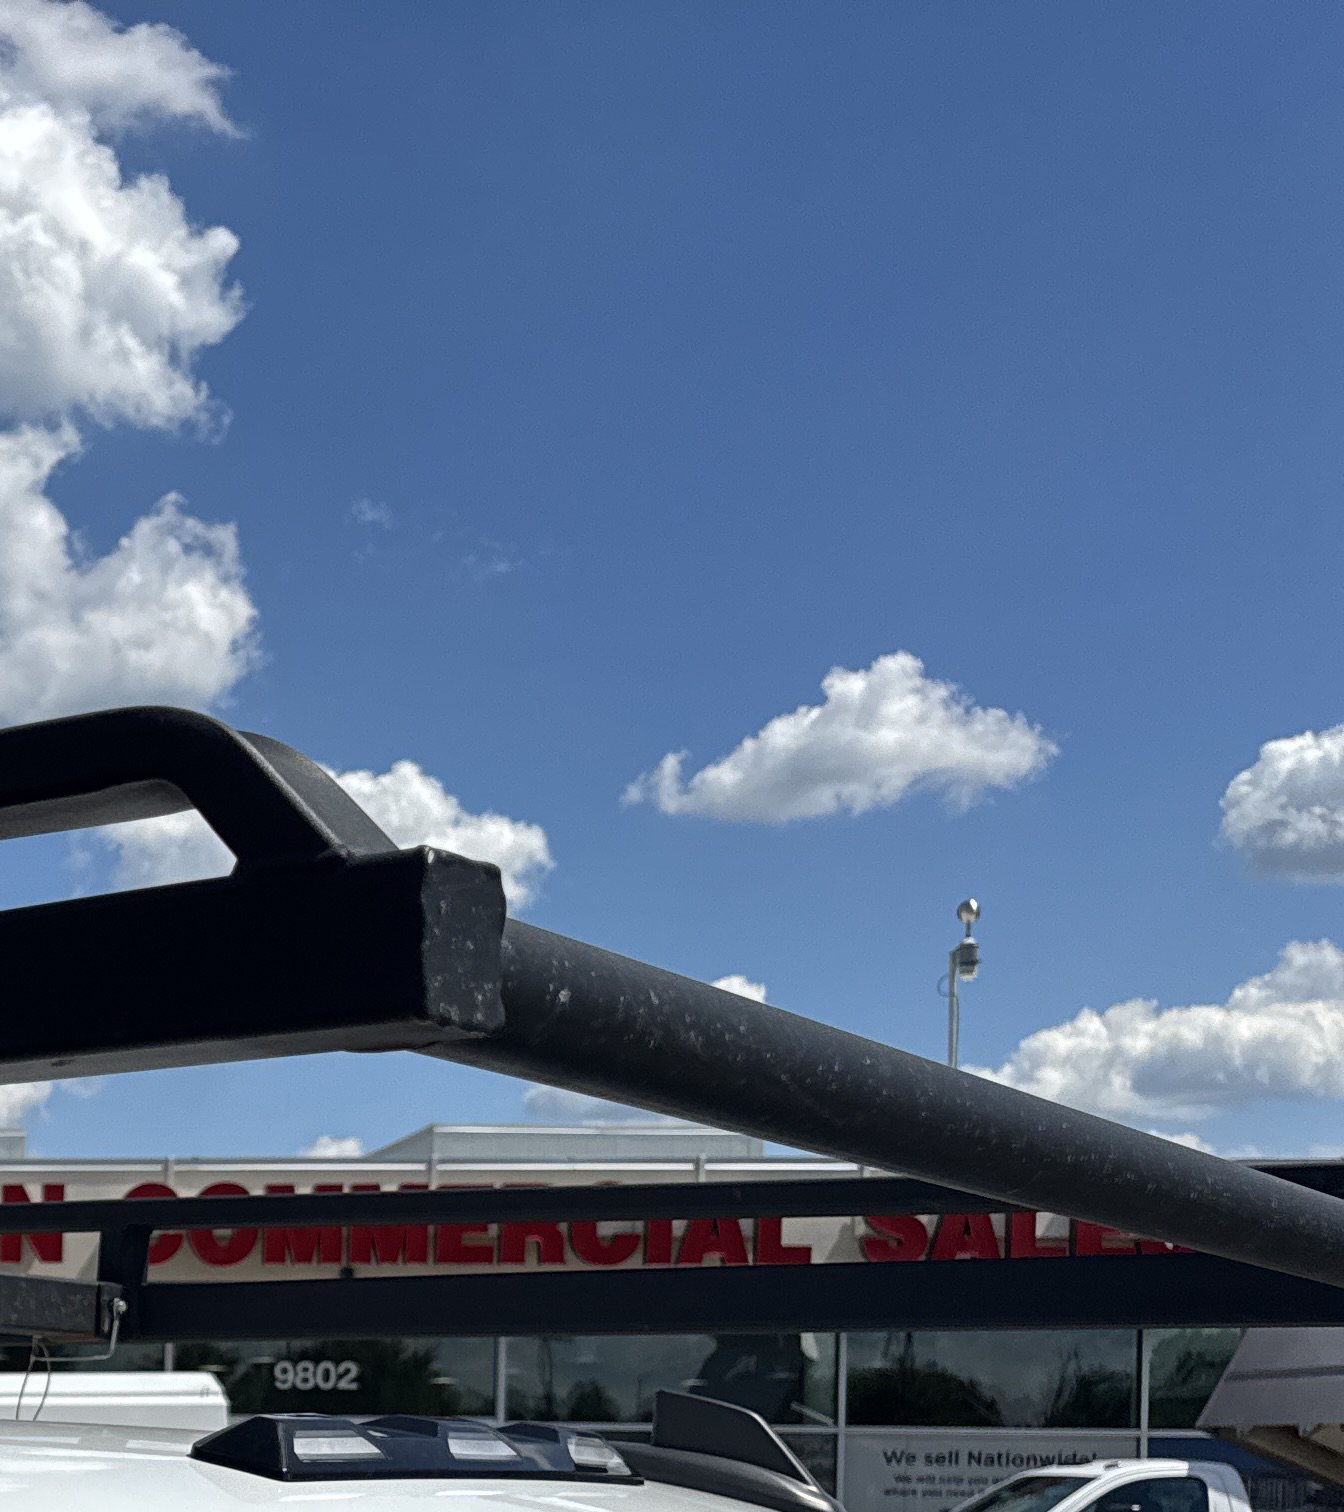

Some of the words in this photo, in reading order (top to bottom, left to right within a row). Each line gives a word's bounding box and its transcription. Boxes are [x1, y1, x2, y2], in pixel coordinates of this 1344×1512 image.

[860, 1212, 1199, 1262] SAL
[273, 1360, 360, 1391] 9802
[882, 1450, 916, 1467] We
[923, 1449, 960, 1467] sell
